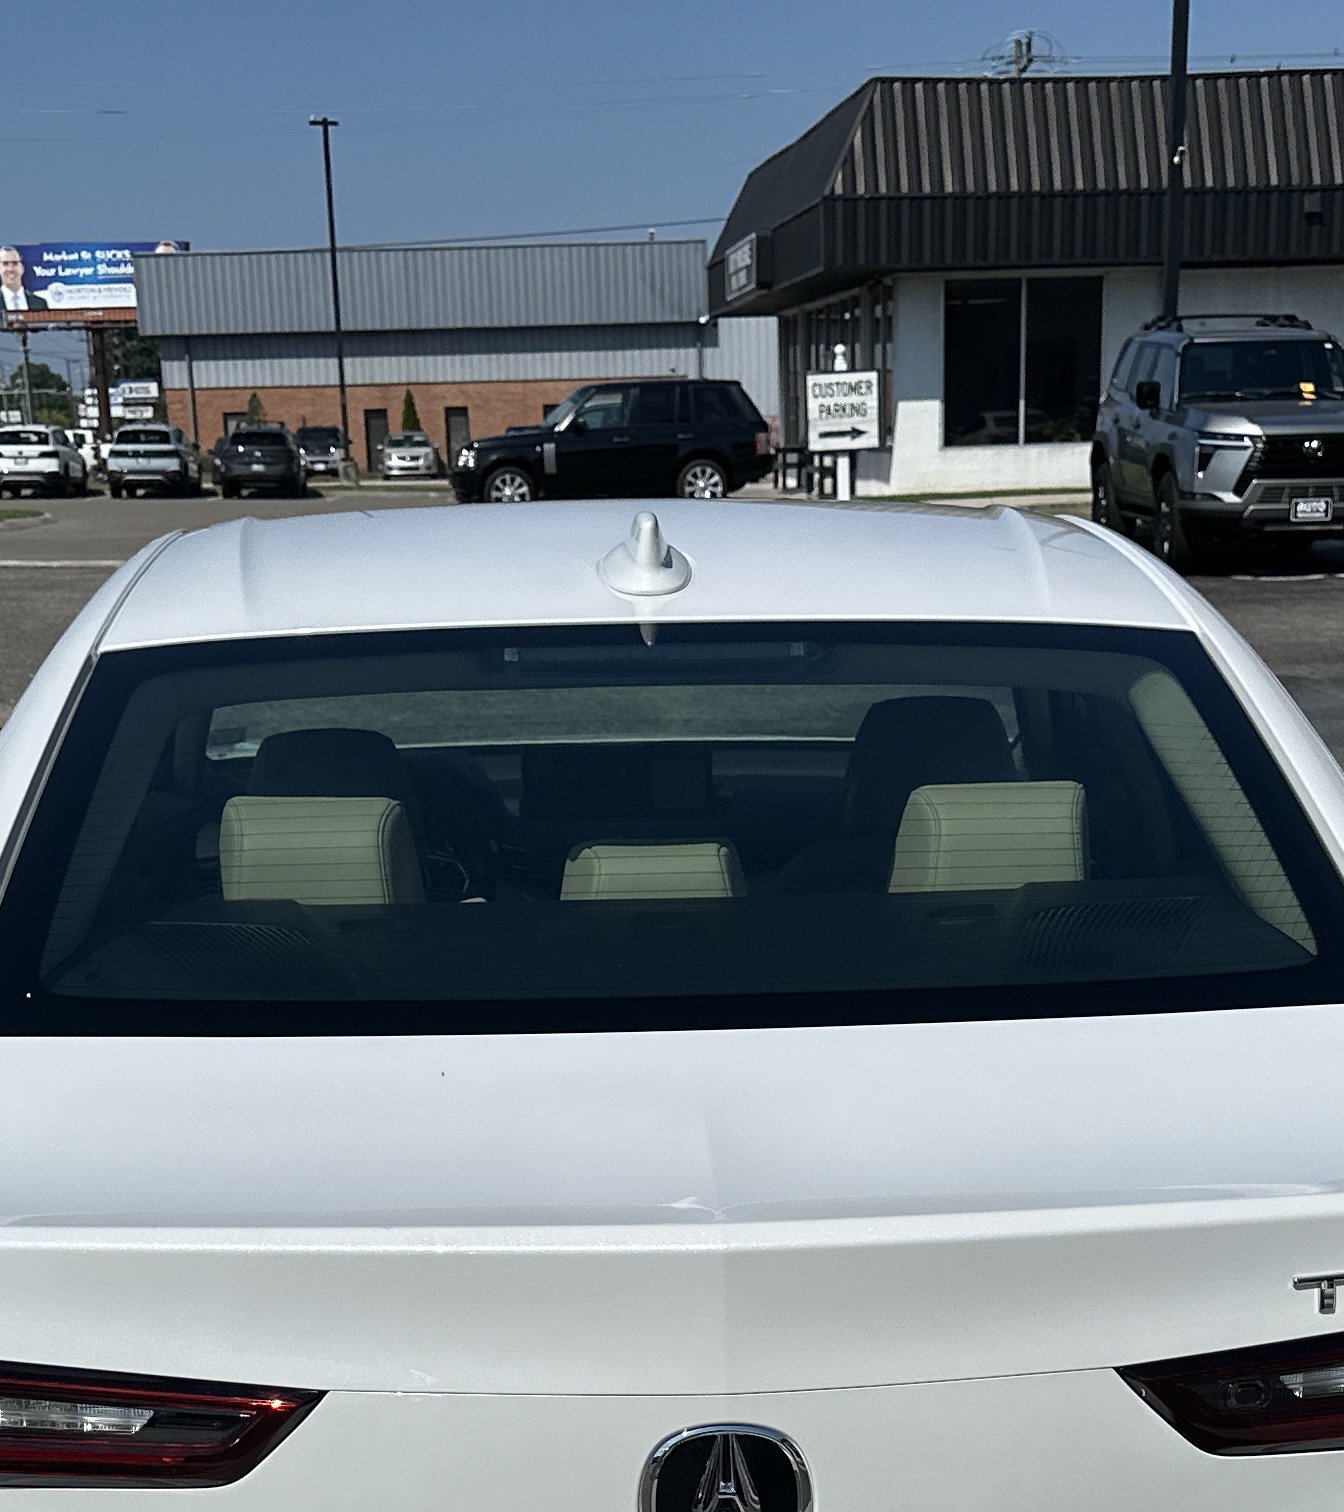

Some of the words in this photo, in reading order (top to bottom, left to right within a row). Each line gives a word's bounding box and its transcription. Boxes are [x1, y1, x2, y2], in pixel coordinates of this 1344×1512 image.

[33, 265, 56, 277] Your
[58, 265, 95, 278] Lawyer
[811, 380, 874, 400] CUSTOMER
[818, 401, 868, 420] PARKING
